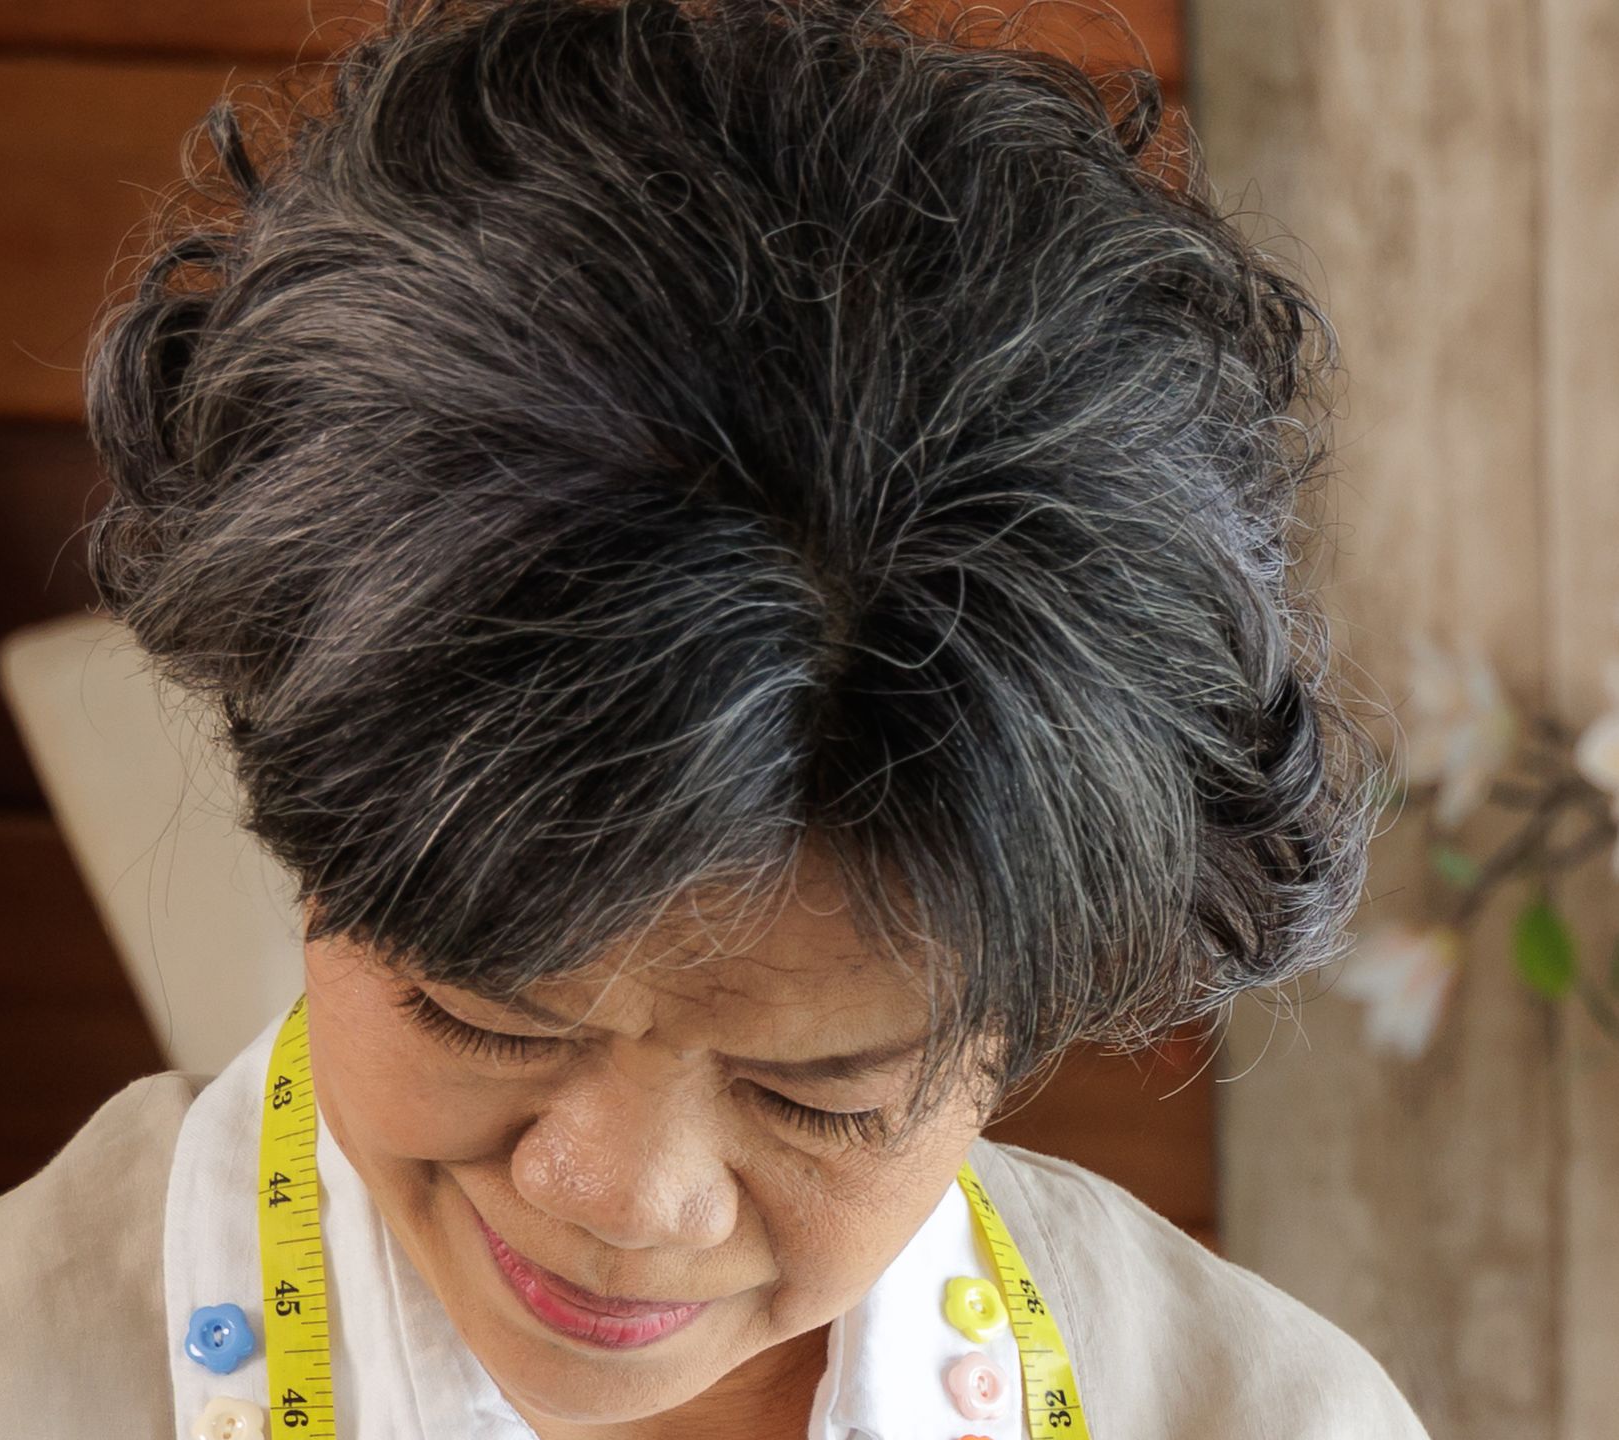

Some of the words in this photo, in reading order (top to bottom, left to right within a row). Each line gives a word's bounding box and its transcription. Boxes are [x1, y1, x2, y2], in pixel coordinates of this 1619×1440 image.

[273, 1075, 292, 1110] 43
[269, 1172, 292, 1208] 44
[275, 1280, 301, 1317] 45
[282, 1388, 309, 1428] 46
[1045, 1389, 1071, 1428] 32
